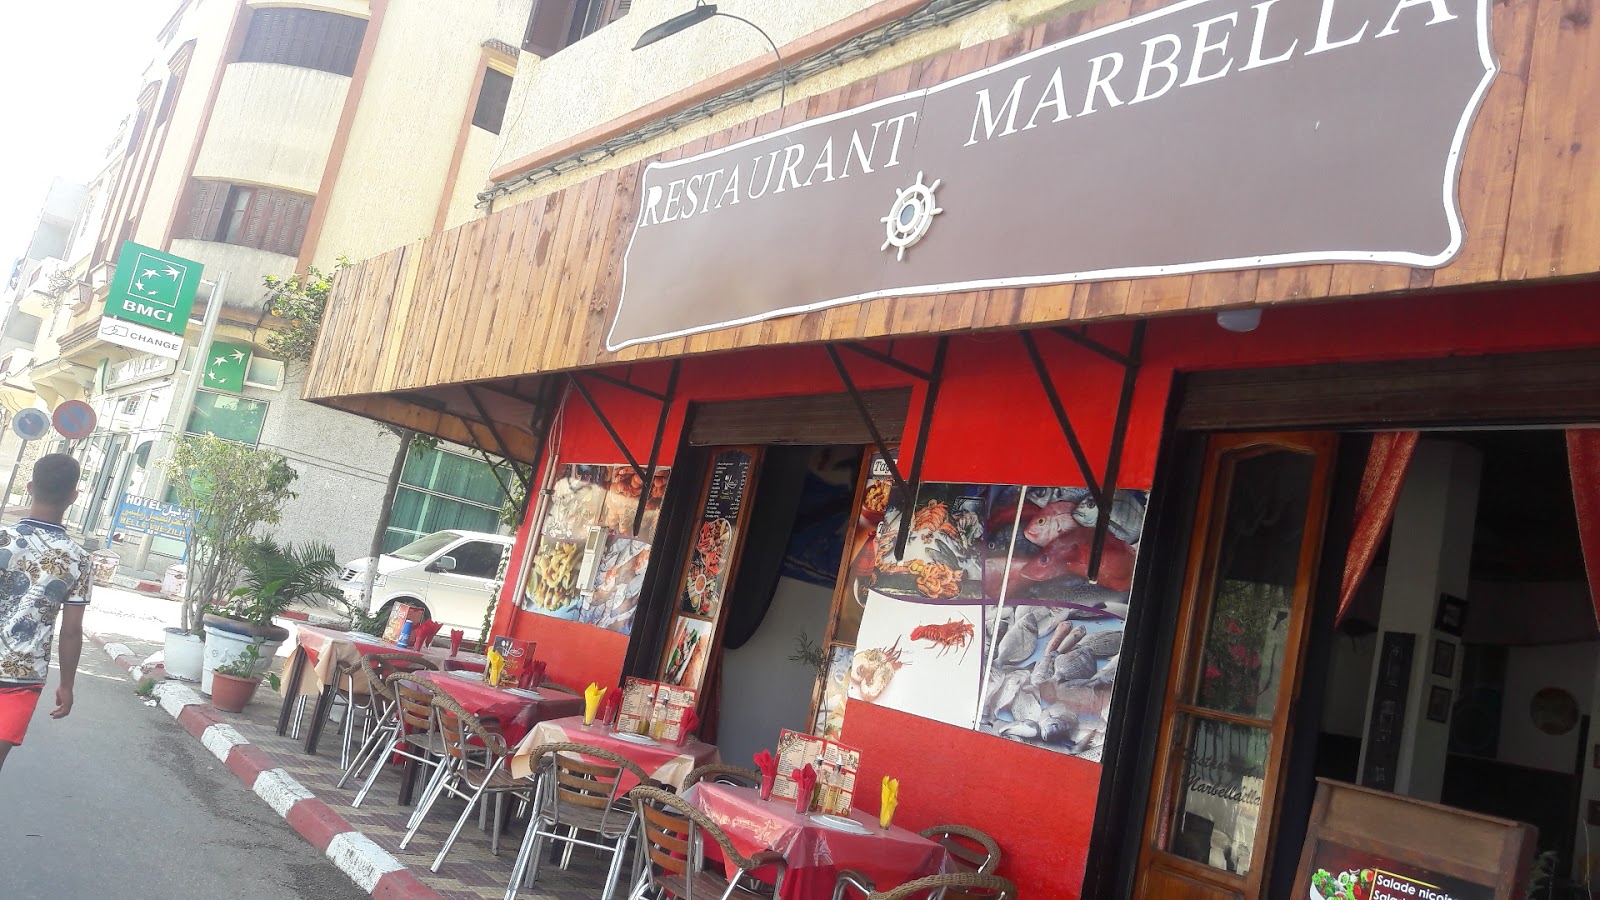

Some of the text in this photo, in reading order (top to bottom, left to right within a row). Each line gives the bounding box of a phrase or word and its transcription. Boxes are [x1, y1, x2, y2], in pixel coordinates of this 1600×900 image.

[640, 112, 917, 228] RESTAURANT
[122, 299, 173, 323] BMCI
[130, 332, 179, 351] CHANGE
[125, 494, 162, 511] HOTEL
[1186, 774, 1243, 802] Marbella
[1376, 874, 1416, 895] Salade
